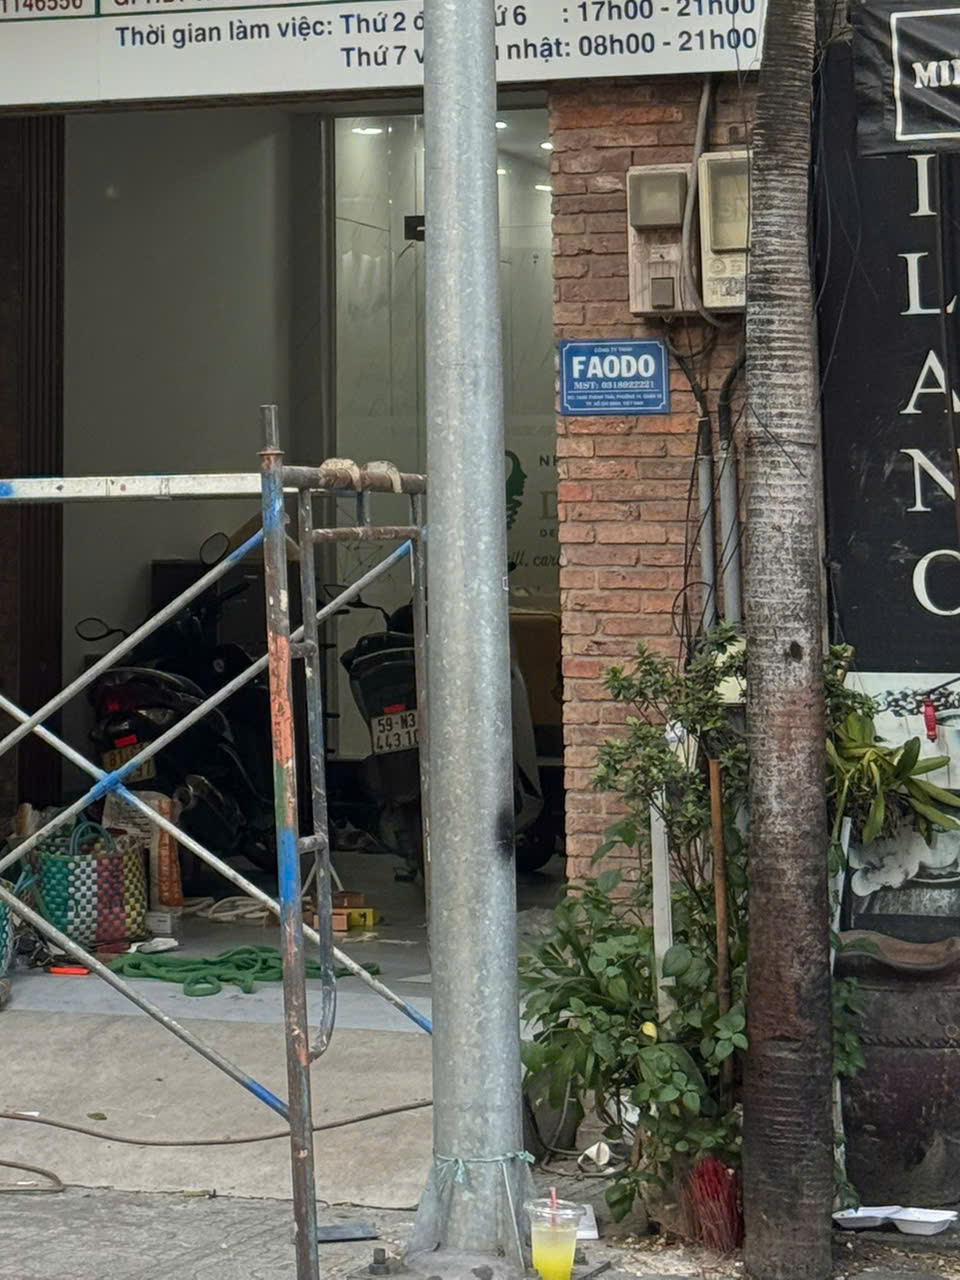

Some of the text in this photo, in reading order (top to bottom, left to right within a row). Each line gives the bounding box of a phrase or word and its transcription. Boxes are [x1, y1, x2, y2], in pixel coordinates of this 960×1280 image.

[512, 4, 527, 26] 6
[115, 22, 165, 47] Thời
[172, 21, 222, 50] gian
[229, 19, 270, 41] làm
[277, 17, 333, 43] việc:
[339, 11, 388, 35] Thứ
[392, 12, 406, 32] 2
[340, 44, 389, 68] Thứ
[393, 45, 408, 66] 7
[507, 36, 571, 64] nhật:
[578, 33, 656, 58] 08h00
[678, 27, 757, 52] 21h00
[571, 354, 656, 379] FAODO
[573, 380, 599, 390] MST:
